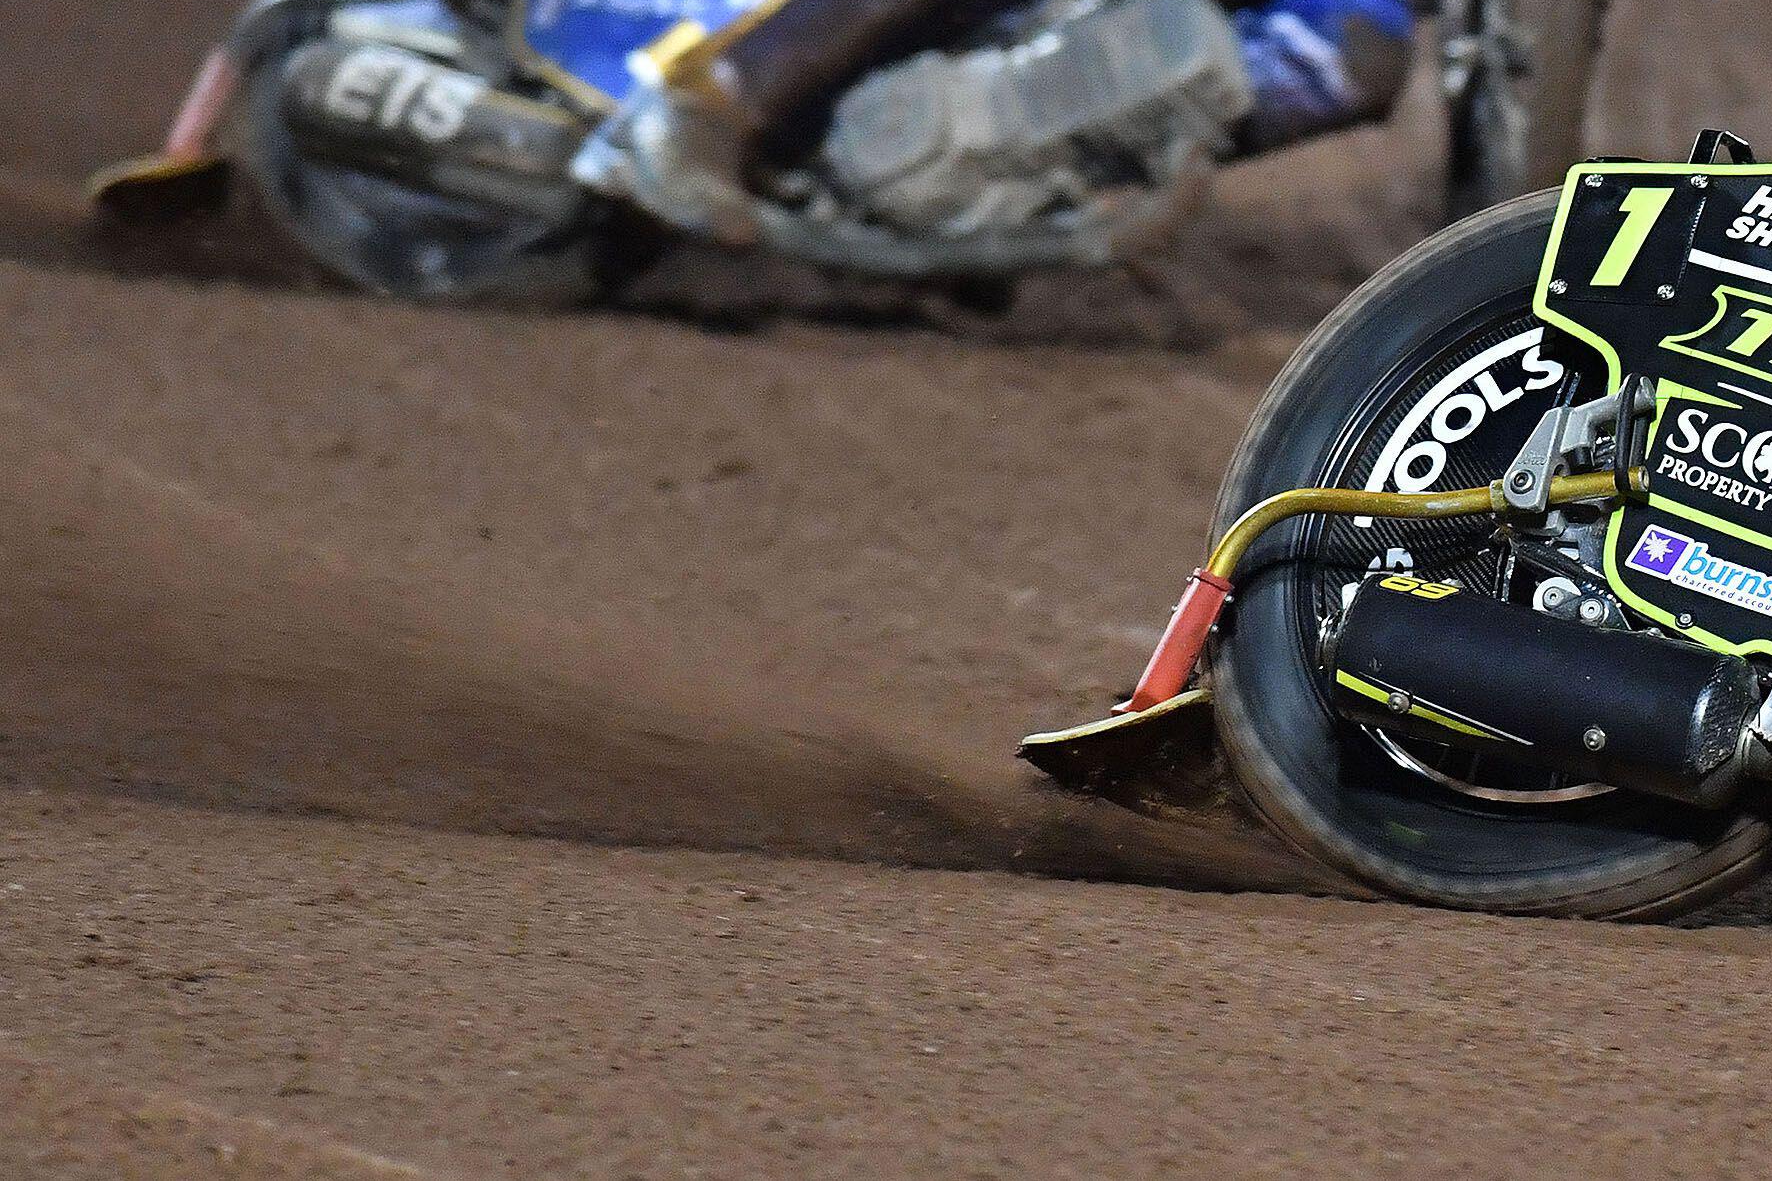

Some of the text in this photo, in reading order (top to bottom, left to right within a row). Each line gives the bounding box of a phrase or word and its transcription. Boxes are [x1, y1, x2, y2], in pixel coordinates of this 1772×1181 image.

[1589, 187, 1675, 286] 1
[1379, 576, 1461, 599] 69
[1675, 574, 1736, 599] chartered
